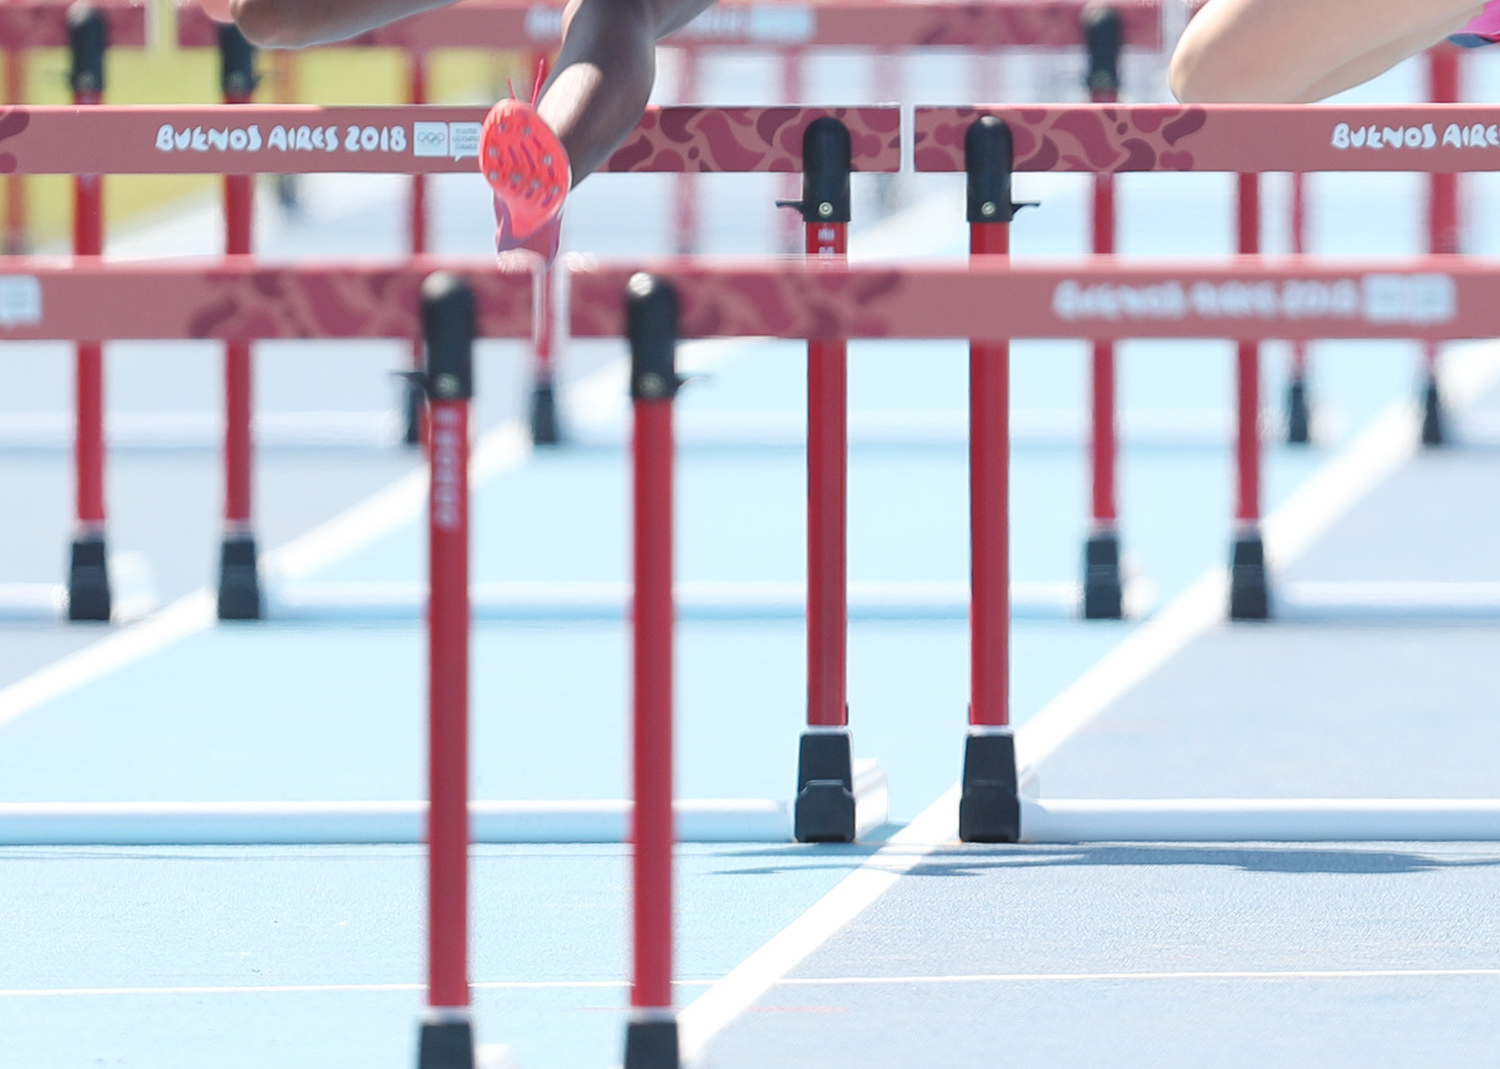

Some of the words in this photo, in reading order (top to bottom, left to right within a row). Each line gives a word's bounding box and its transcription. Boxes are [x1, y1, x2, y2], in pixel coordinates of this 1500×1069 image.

[155, 124, 263, 152] BUENOS
[268, 125, 339, 152] AIRES
[344, 125, 407, 152] 2018
[1330, 123, 1437, 149] BUENOS
